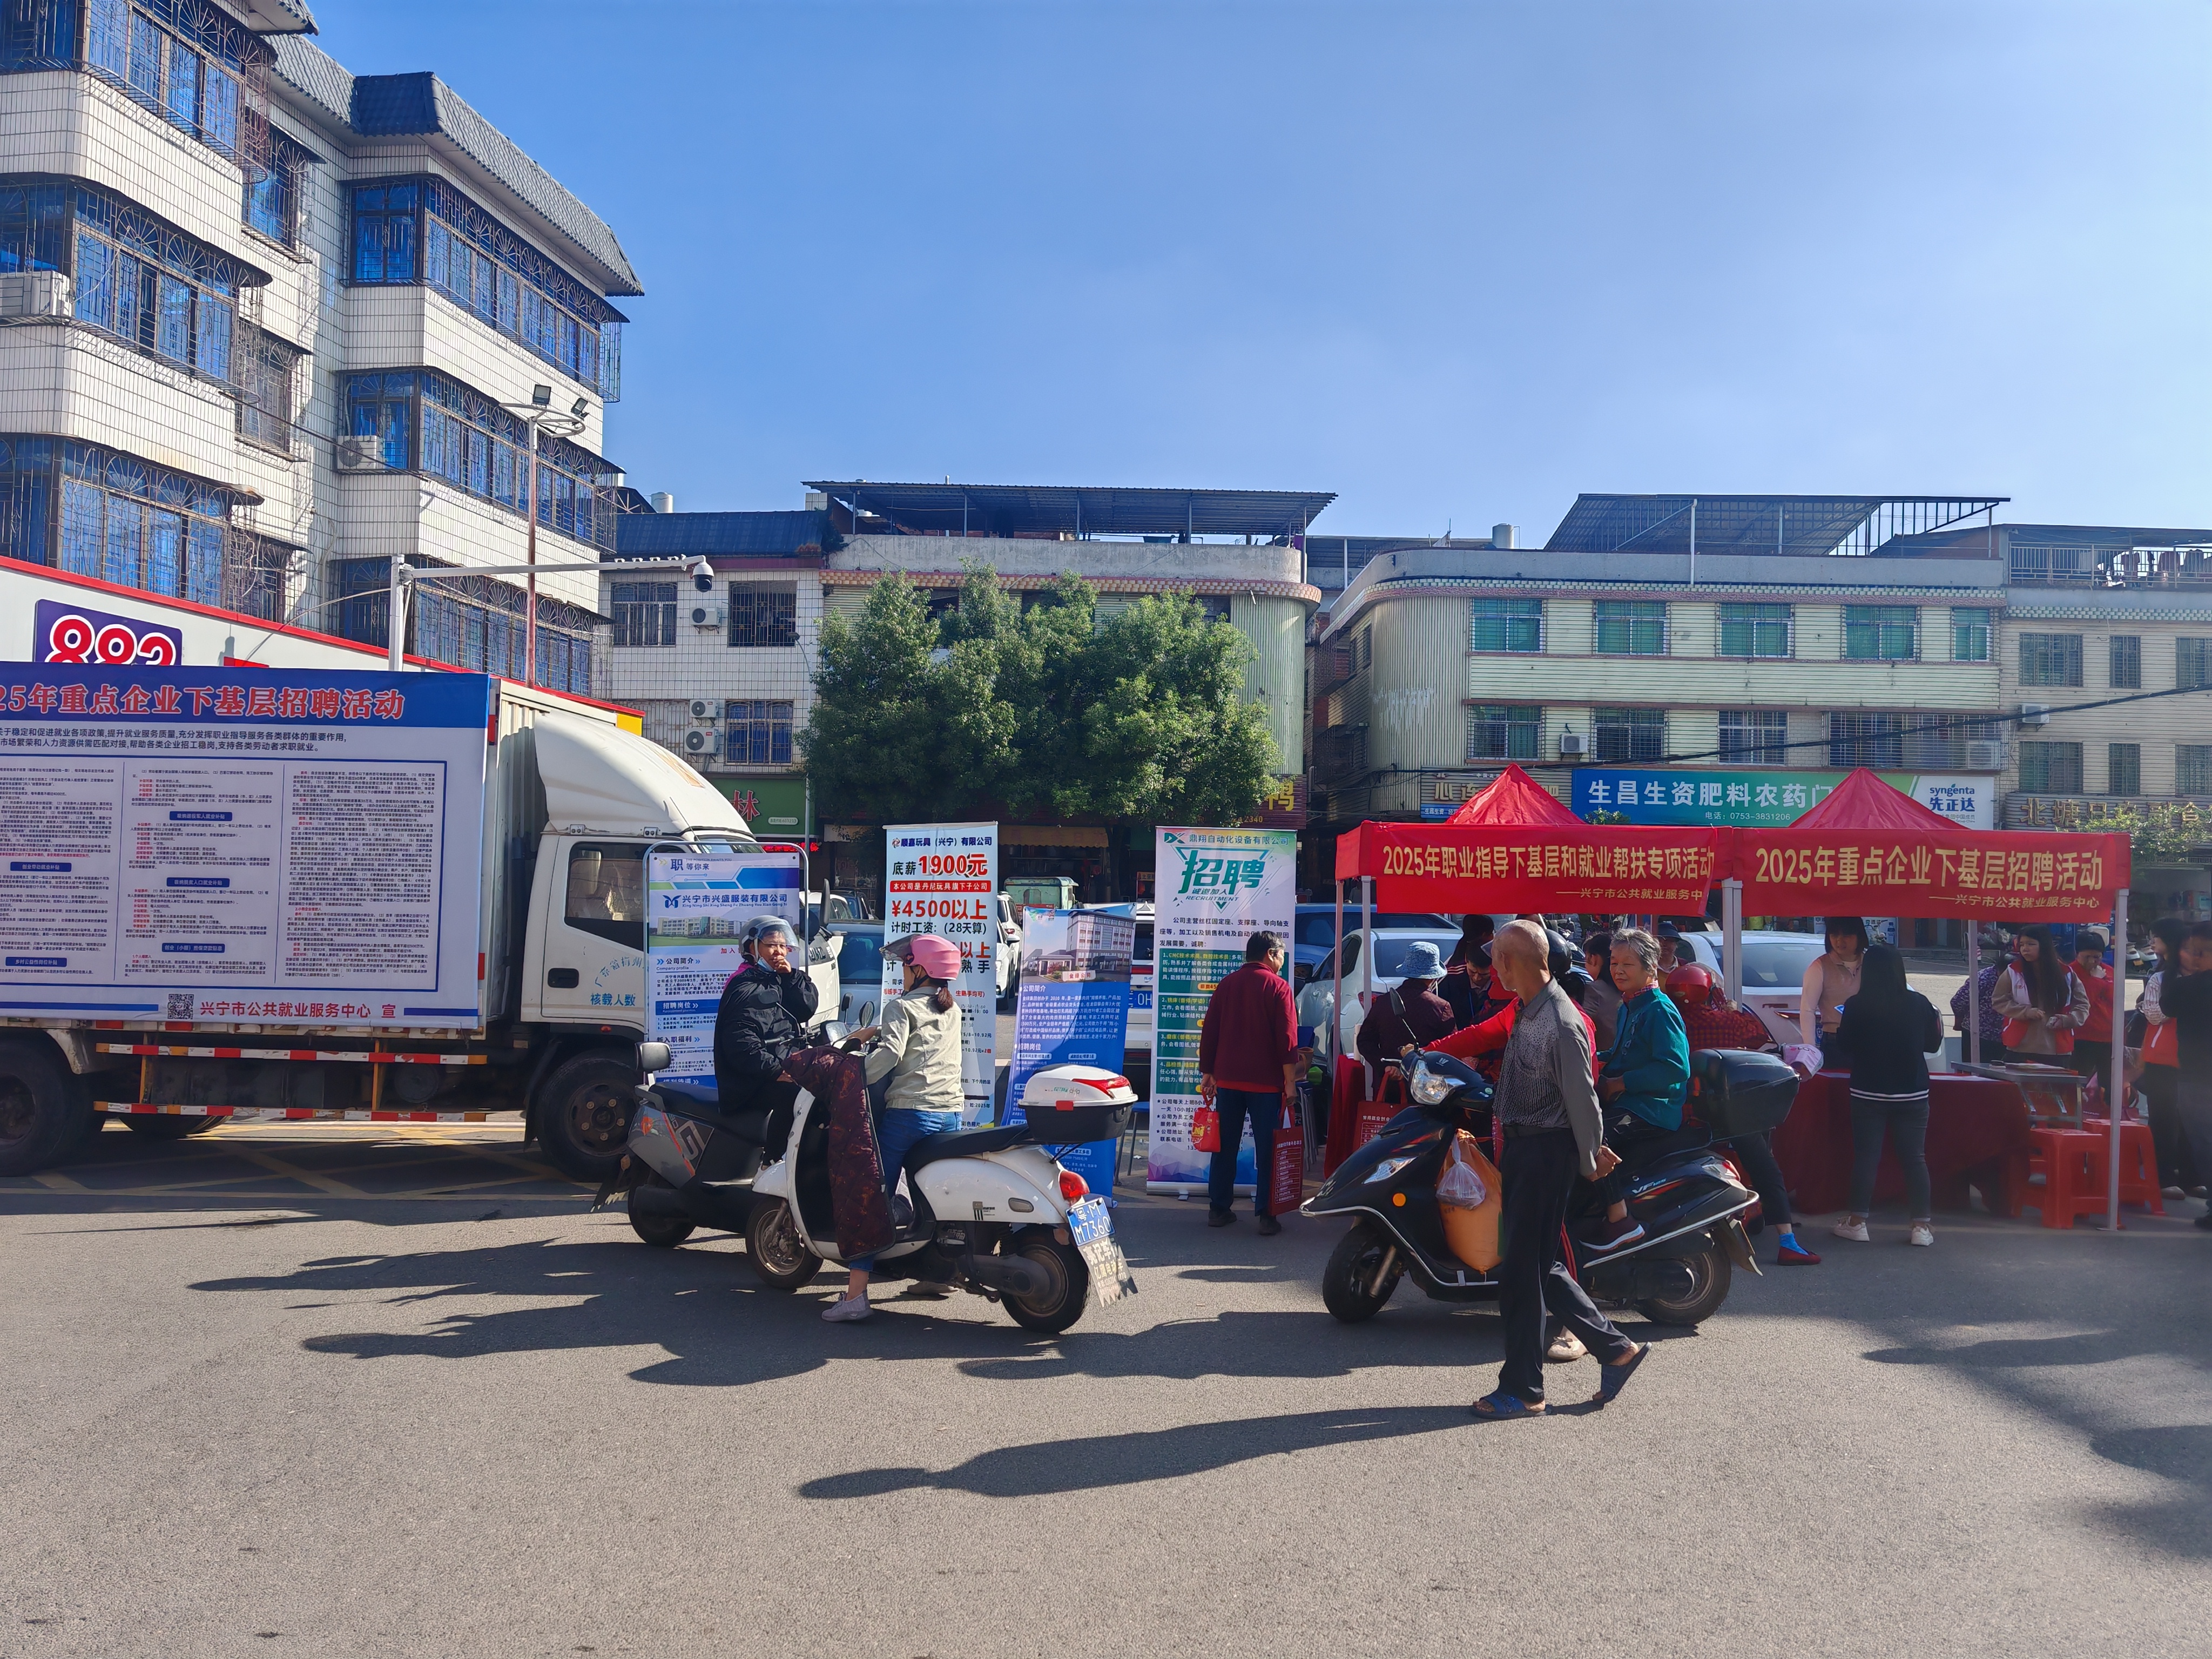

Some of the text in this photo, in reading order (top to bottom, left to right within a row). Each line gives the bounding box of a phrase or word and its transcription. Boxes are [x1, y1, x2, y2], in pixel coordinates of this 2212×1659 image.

[1588, 779, 1833, 808] 生昌生资肥料农药门
[1930, 786, 1975, 797] syngenta
[1930, 797, 1975, 812] 先正达
[1189, 834, 1289, 846] 鼎翔自动化设备有限公司
[670, 858, 684, 871] 职
[686, 863, 710, 871] 等你来
[892, 854, 988, 876] 底薪 1900元
[1383, 844, 1715, 881] 2025年职业指导下基层和就业帮扶专项活动
[1756, 845, 2103, 893] 2025年重点企业下基层招聘活动
[1178, 850, 1266, 895] 招聘
[893, 882, 988, 891] 本公司是丹尼玩具旗下子公司
[682, 894, 788, 903] 兴宁市兴盛服装有限公司
[892, 899, 988, 920] ¥4500以上
[1022, 984, 1046, 993] 公司简介
[590, 993, 636, 1007] 核载人数
[200, 1001, 397, 1019] 兴宁市公共就业服务中心 宣
[1018, 1043, 1041, 1051] 招聘岗位
[1074, 1216, 1111, 1243] M7360
